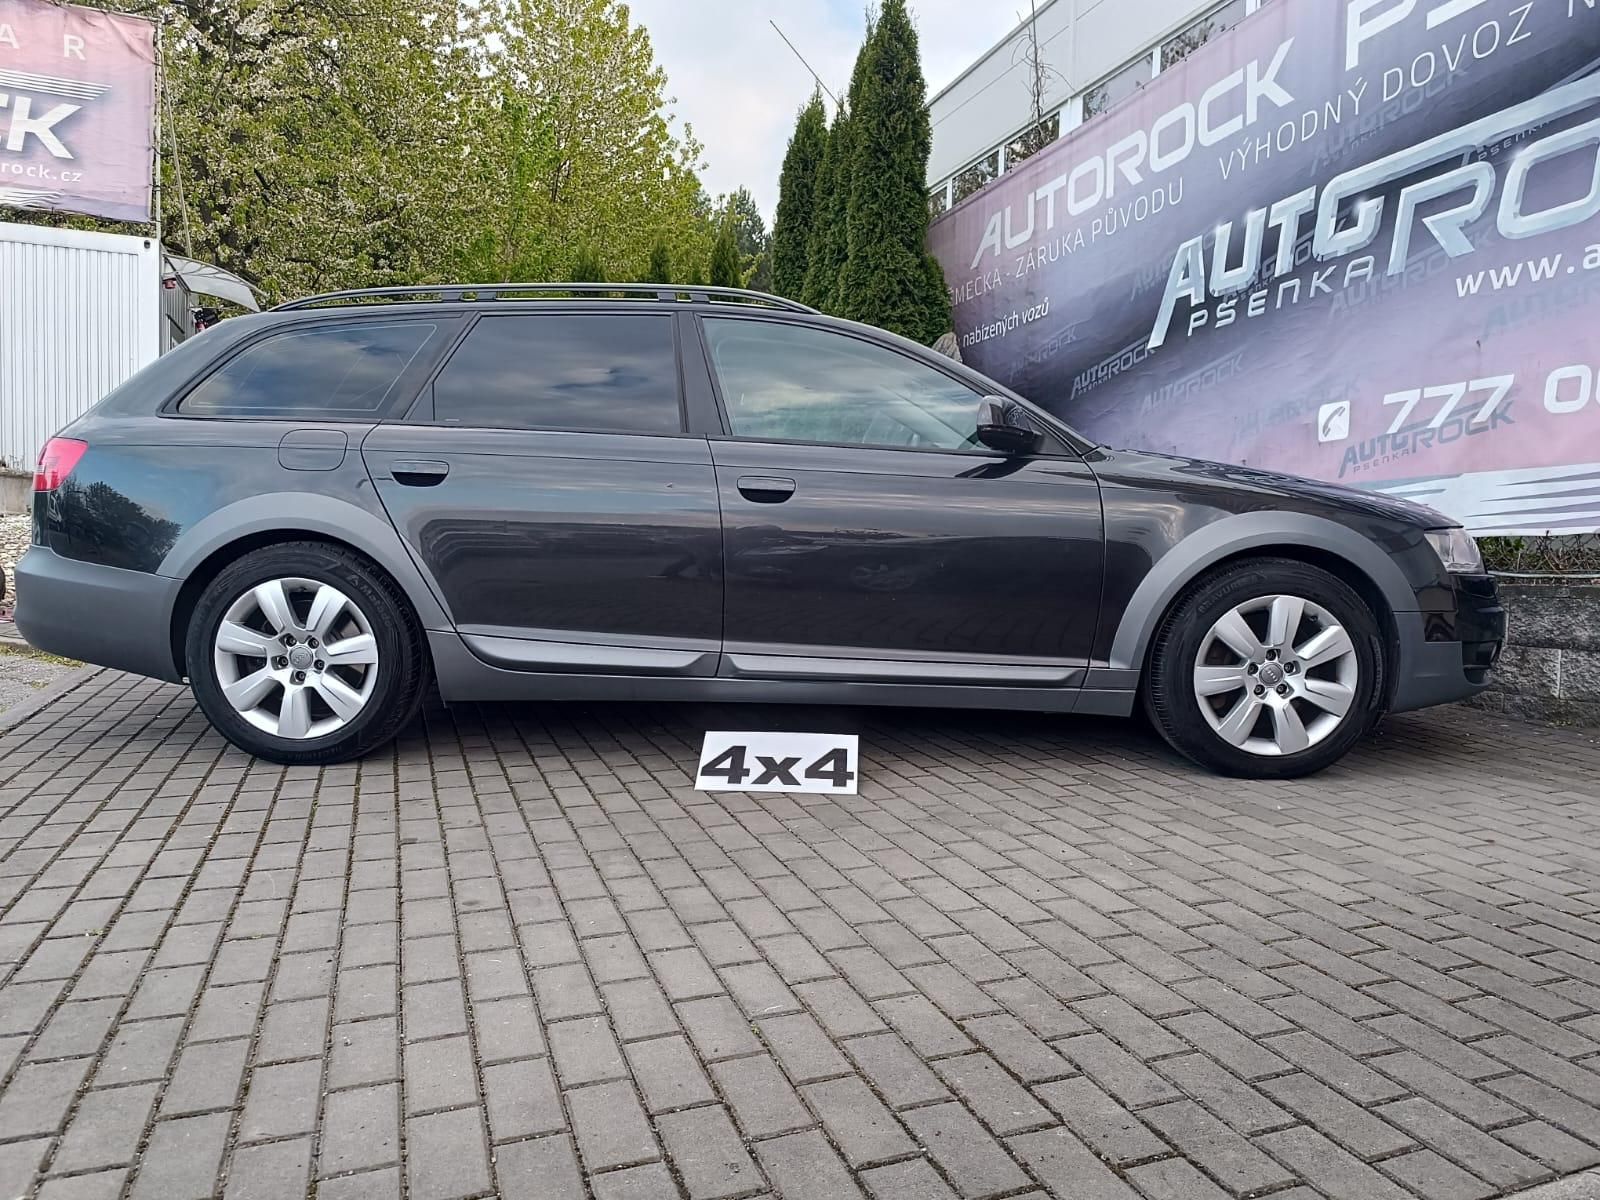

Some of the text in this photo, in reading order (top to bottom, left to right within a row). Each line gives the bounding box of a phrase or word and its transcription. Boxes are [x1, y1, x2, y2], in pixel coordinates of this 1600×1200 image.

[0, 93, 83, 159] K
[970, 36, 1295, 270] AUTOROCK
[1015, 228, 1085, 279] ZÁRUKA
[1091, 176, 1183, 242] PŮVODU
[1219, 77, 1368, 180] VÝHODNÝ
[1383, 1, 1534, 102] DOVOZ
[962, 296, 1049, 347] nabízených vozů
[1383, 374, 1515, 435] 777
[700, 745, 854, 788] 4x4
